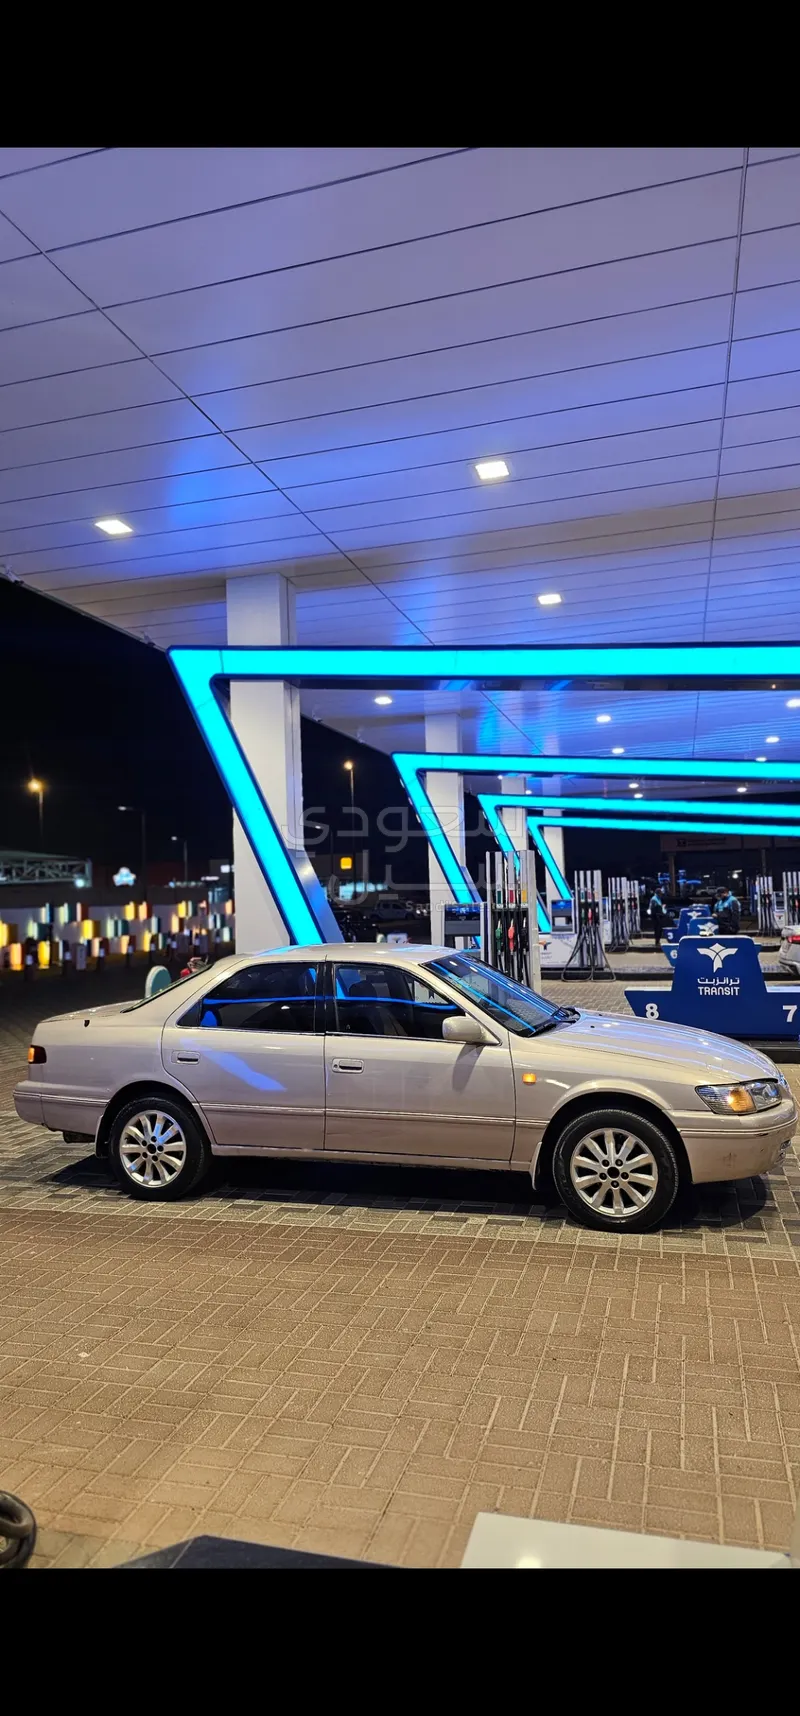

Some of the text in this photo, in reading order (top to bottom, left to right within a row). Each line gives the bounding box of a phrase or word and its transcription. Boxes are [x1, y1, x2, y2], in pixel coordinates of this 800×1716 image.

[667, 932, 673, 940] 3
[670, 949, 678, 959] 6
[697, 977, 740, 986] ترانزيت
[698, 986, 740, 996] TRANSIT
[645, 1003, 659, 1020] 8
[782, 1005, 797, 1022] 7
